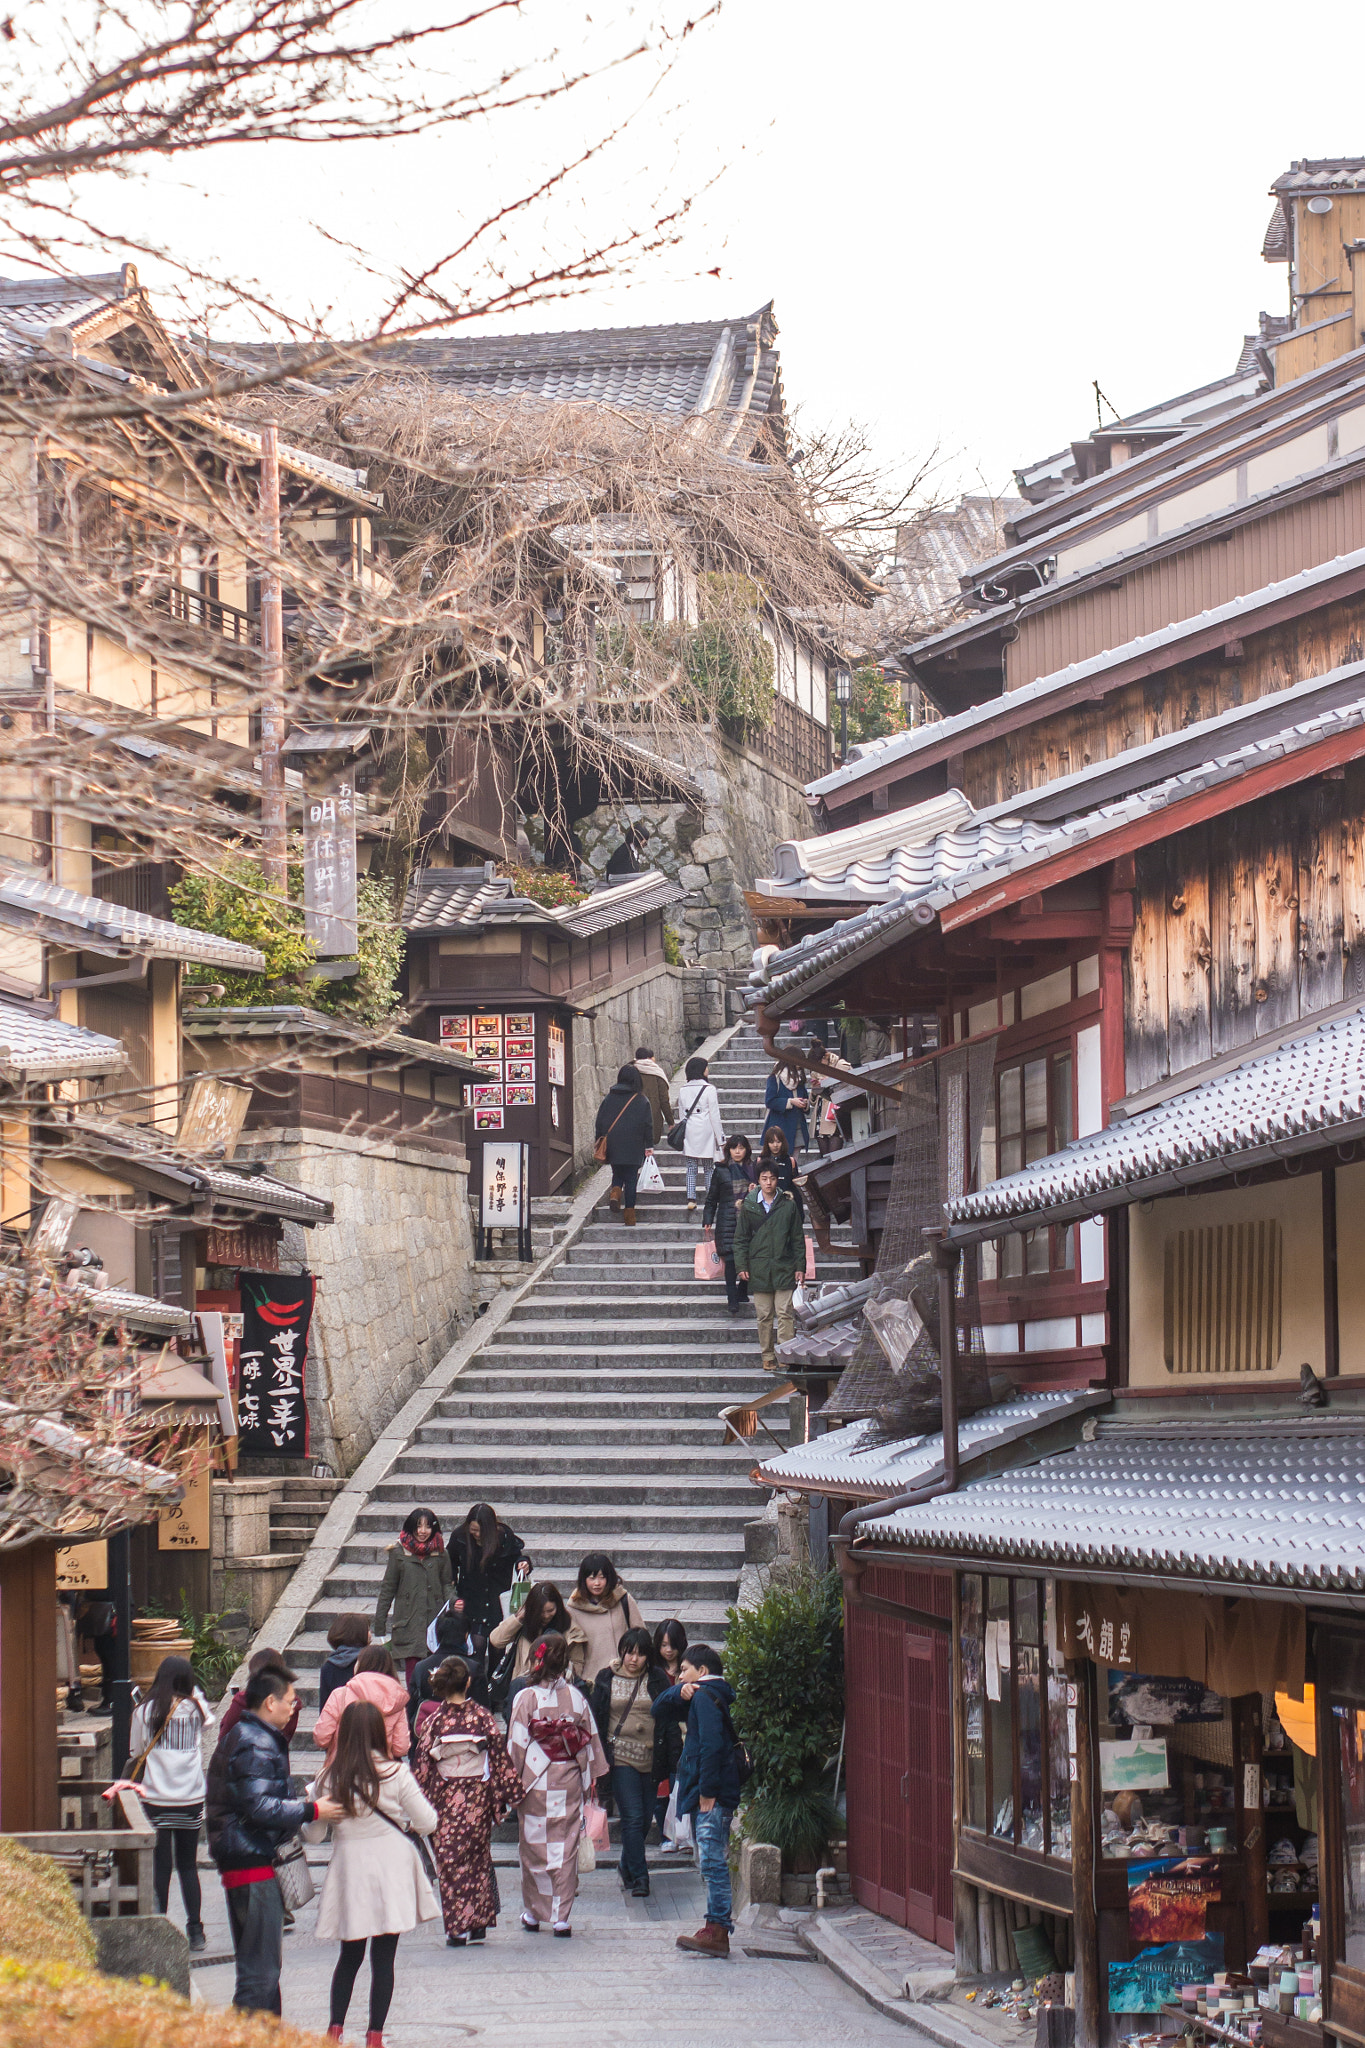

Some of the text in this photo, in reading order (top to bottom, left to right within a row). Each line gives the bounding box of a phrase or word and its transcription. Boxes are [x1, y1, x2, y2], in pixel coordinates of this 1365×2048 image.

[310, 797, 337, 931] 明保野亭
[495, 1157, 507, 1213] 明保野亭
[238, 1350, 265, 1430] 一味・七味
[266, 1328, 302, 1447] 世界一辛い
